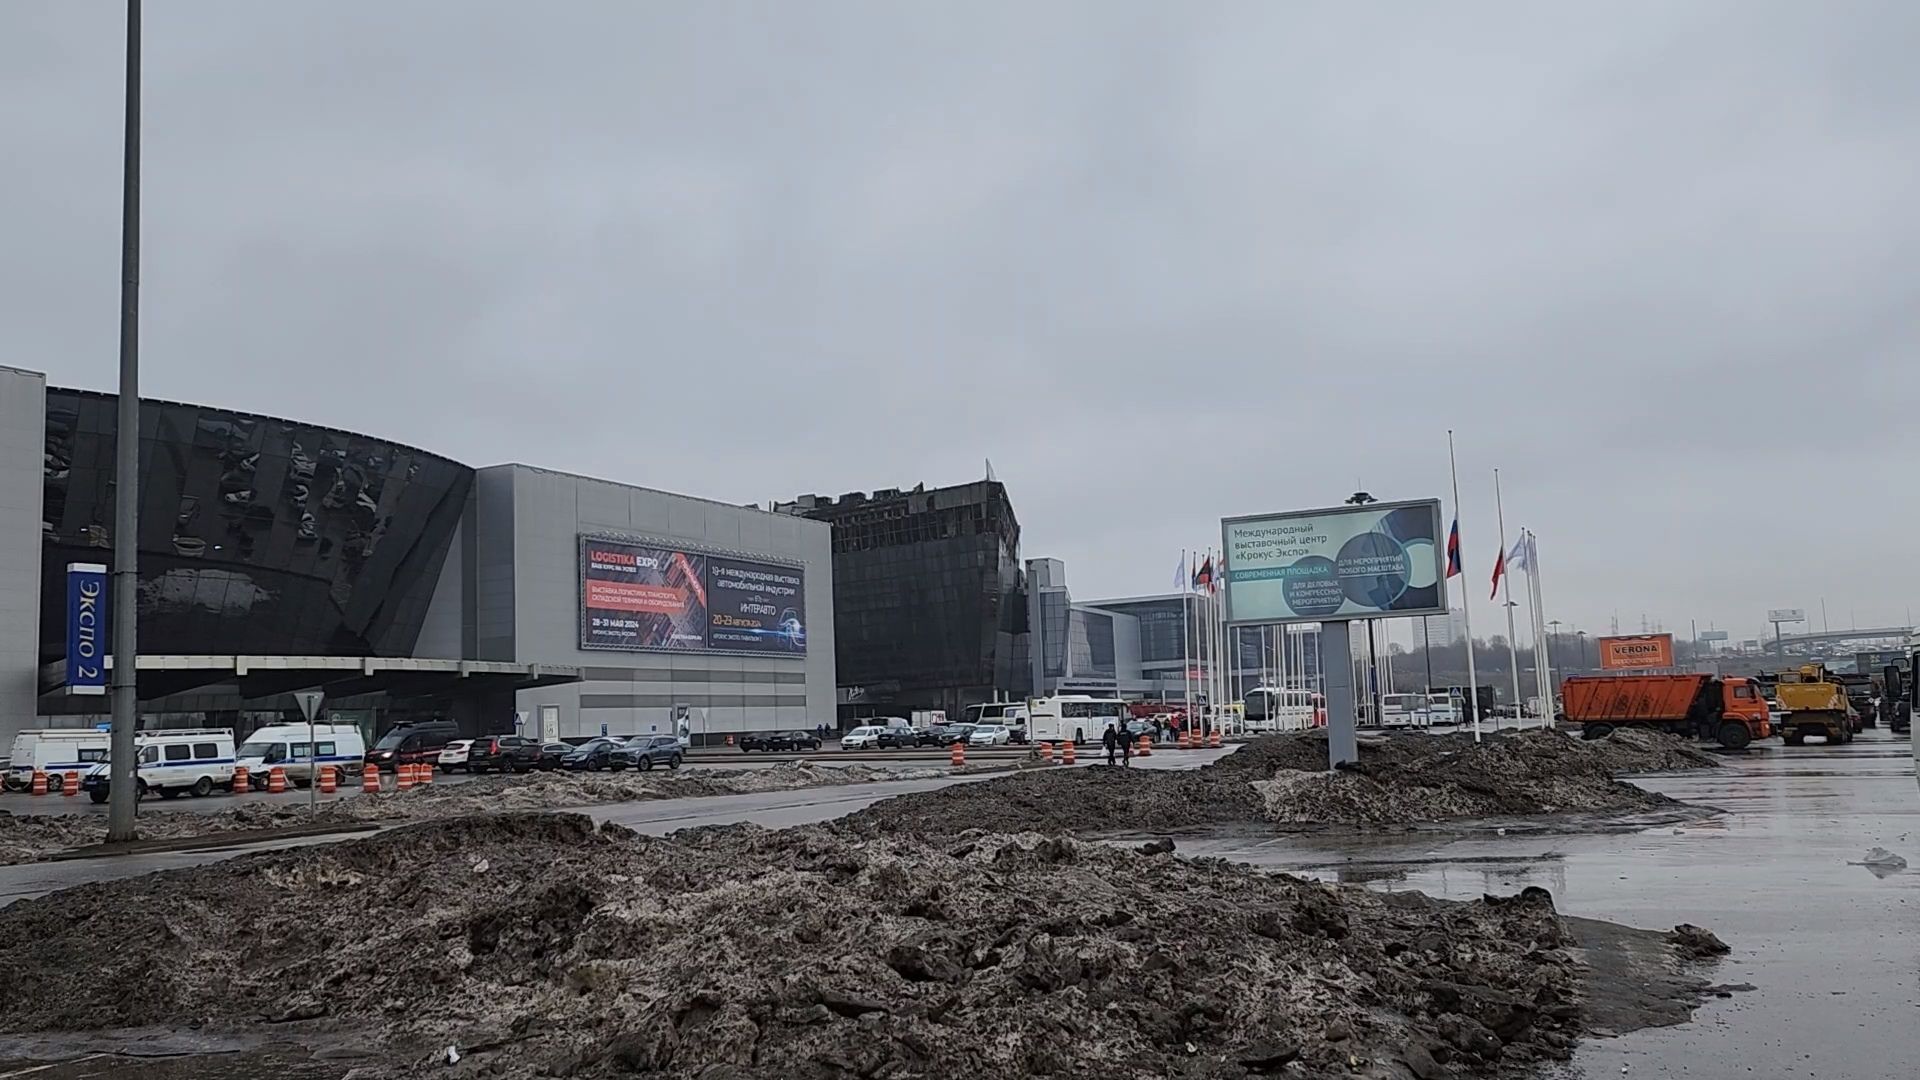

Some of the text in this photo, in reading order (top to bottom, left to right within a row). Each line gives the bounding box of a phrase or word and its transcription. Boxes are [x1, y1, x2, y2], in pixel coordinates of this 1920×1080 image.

[1234, 524, 1313, 538] Международный
[1234, 535, 1327, 549] выставочный центр
[591, 551, 658, 569] LOGISTIKA EXPO
[1235, 548, 1309, 561] «Крокус Экспо»
[1338, 554, 1403, 567] ДЛЯ МЕРОПРИЯТИЙ
[1235, 565, 1328, 579] СОВРЕМЕННАЯ ПЛОЩАДКА
[1338, 563, 1405, 575] ЛЮБОГО МАСШТАБА
[726, 569, 774, 581] международная
[774, 574, 800, 585] выставка
[717, 579, 795, 596] автомобильной индустрии
[1307, 580, 1339, 588] ДЕЛОВЫХ
[1295, 588, 1343, 597] КОНГРЕССНЫХ
[1292, 595, 1341, 606] МЕРОПРИЯТИЙ
[740, 603, 776, 616] ИНТЕРАВТО
[592, 618, 639, 629] 28-31 МАЯ 2024
[712, 614, 732, 626] 20-23
[1614, 645, 1658, 654] VERONA
[78, 665, 98, 678] 2
